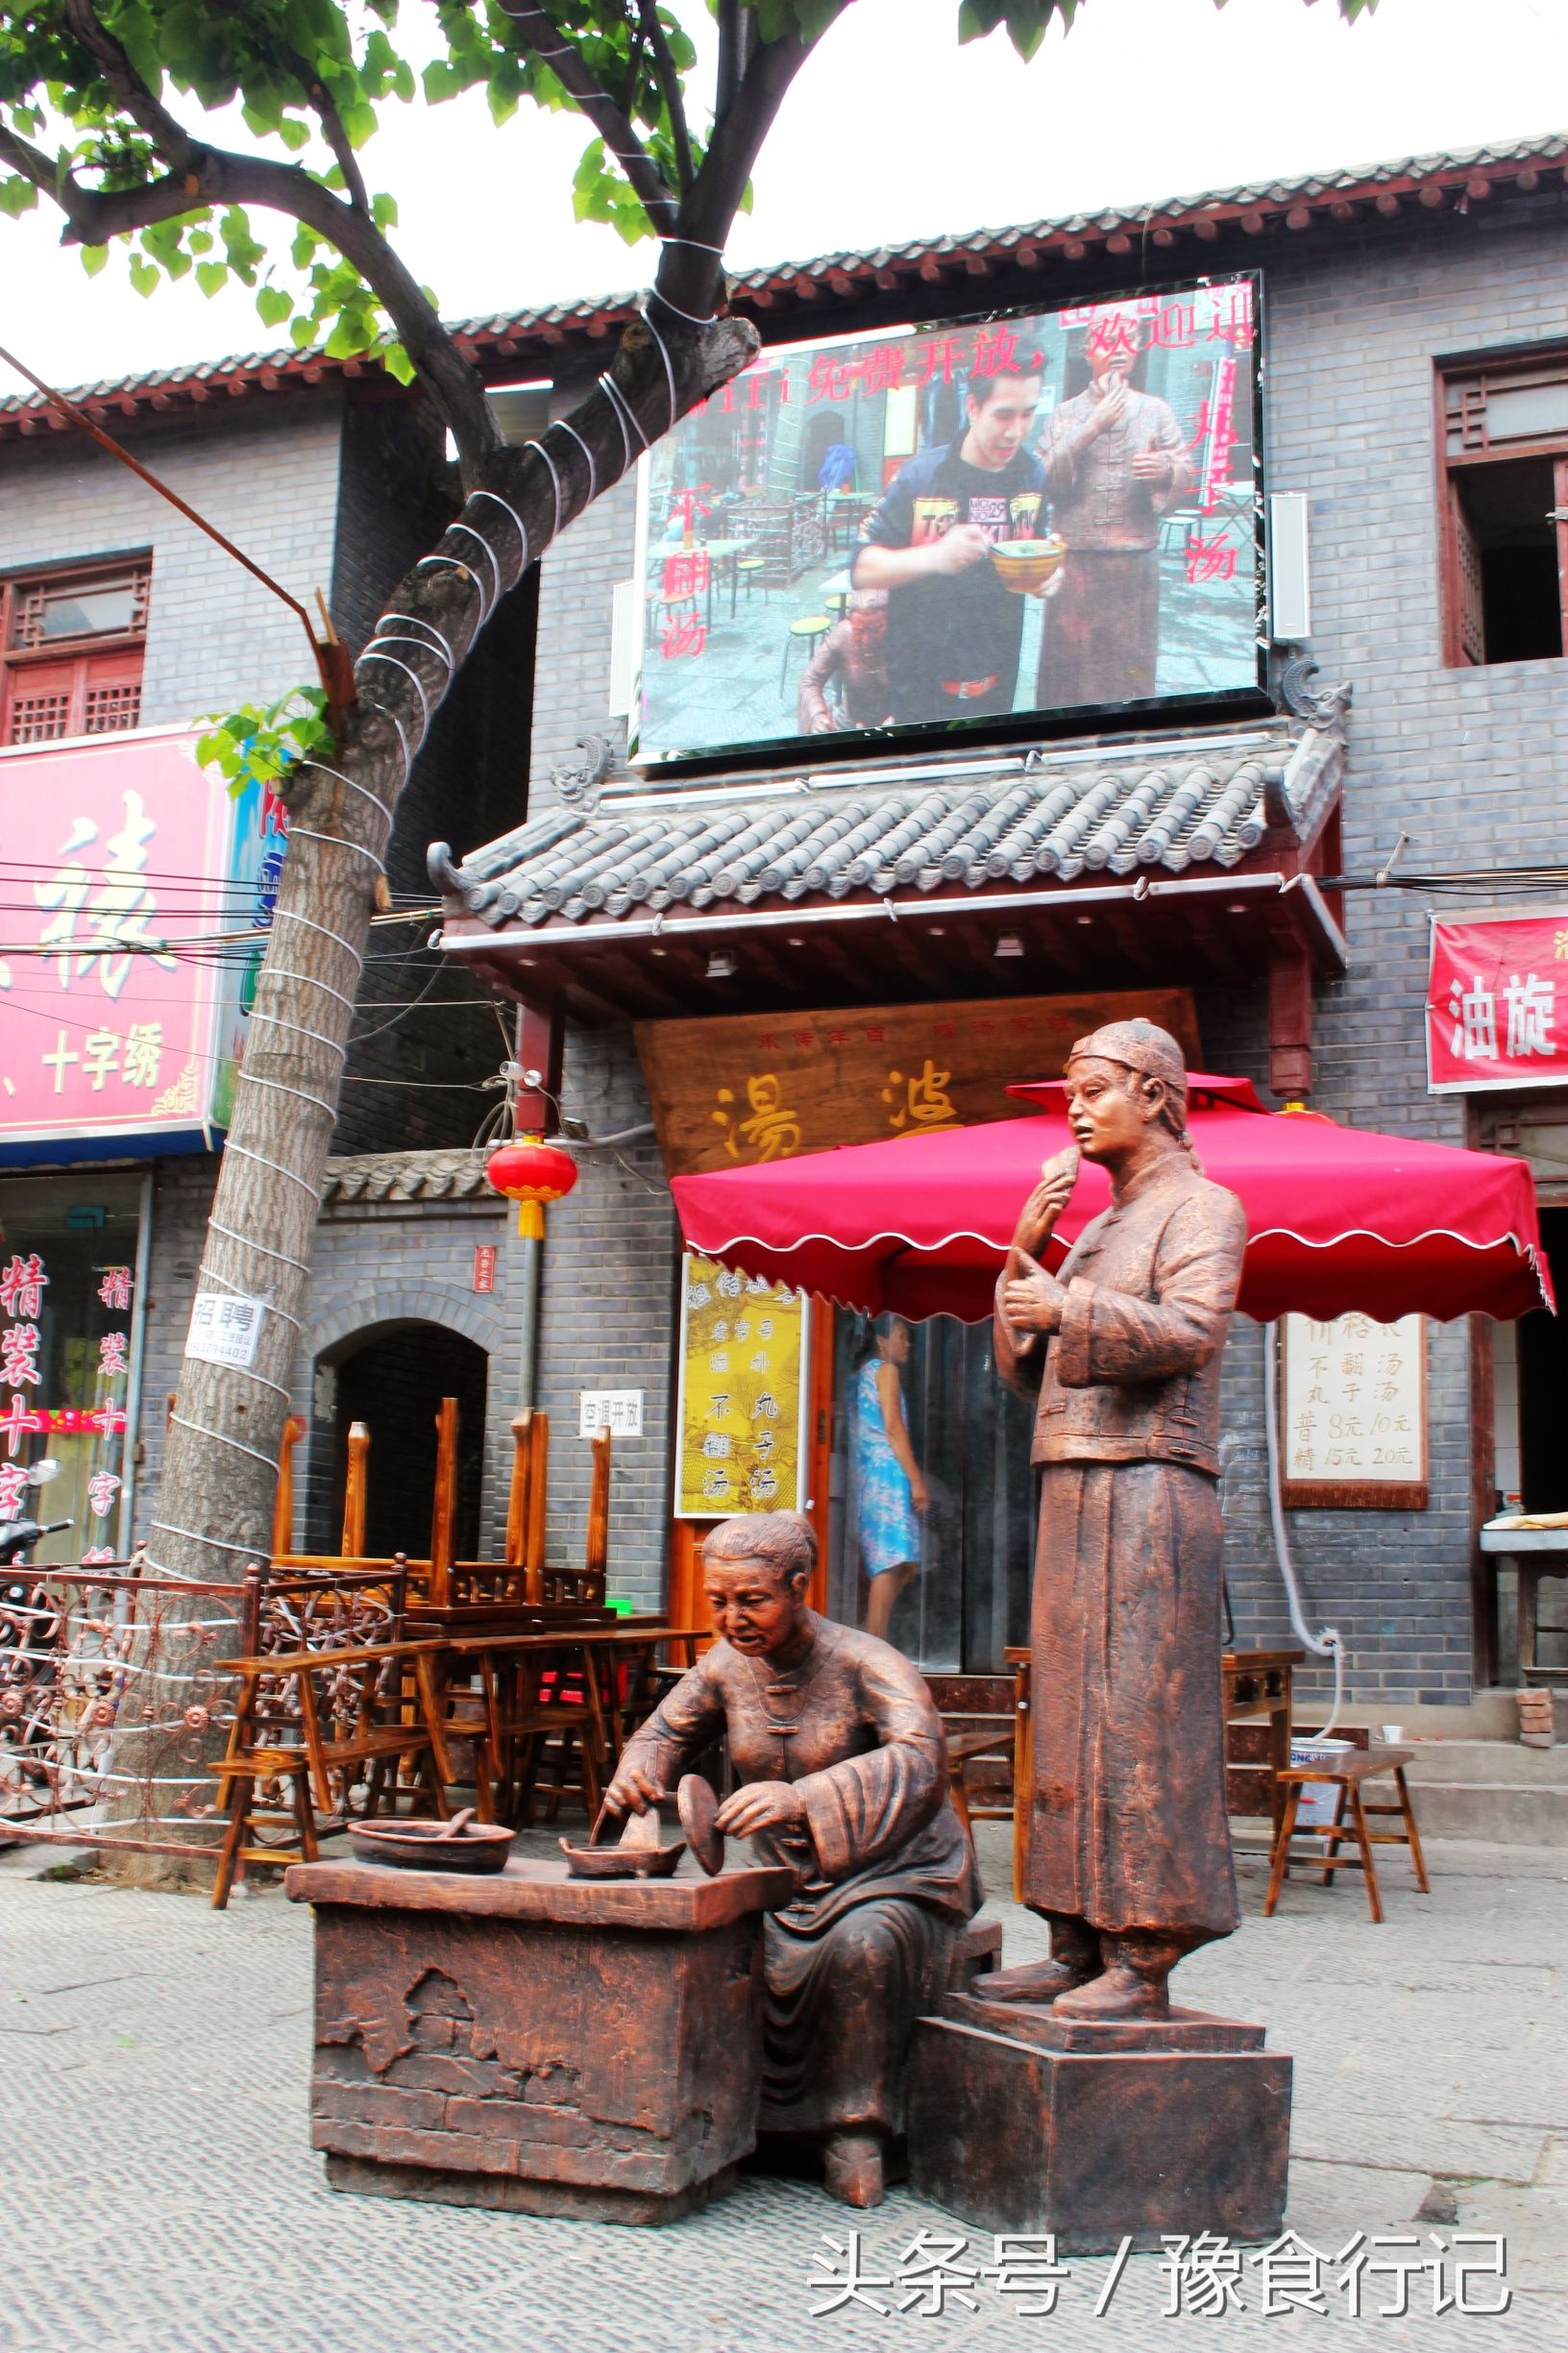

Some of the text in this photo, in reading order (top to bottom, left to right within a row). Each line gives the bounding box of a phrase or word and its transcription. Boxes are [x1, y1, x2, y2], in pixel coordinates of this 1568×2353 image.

[660, 482, 713, 661] 不翻汤
[1448, 971, 1558, 1061] 油旋
[193, 1299, 255, 1332] 招聘
[709, 1319, 774, 1343] 老字号
[1307, 1352, 1405, 1379] 不翻汤
[0, 1252, 51, 1567] 精装十字
[583, 1398, 639, 1430] 空调开放
[1292, 1409, 1412, 1443] 普 8元 10元
[701, 1393, 732, 1499] 不翻汤
[749, 1390, 780, 1499] 丸子汤
[1292, 1445, 1414, 1472] 精 15元 20元
